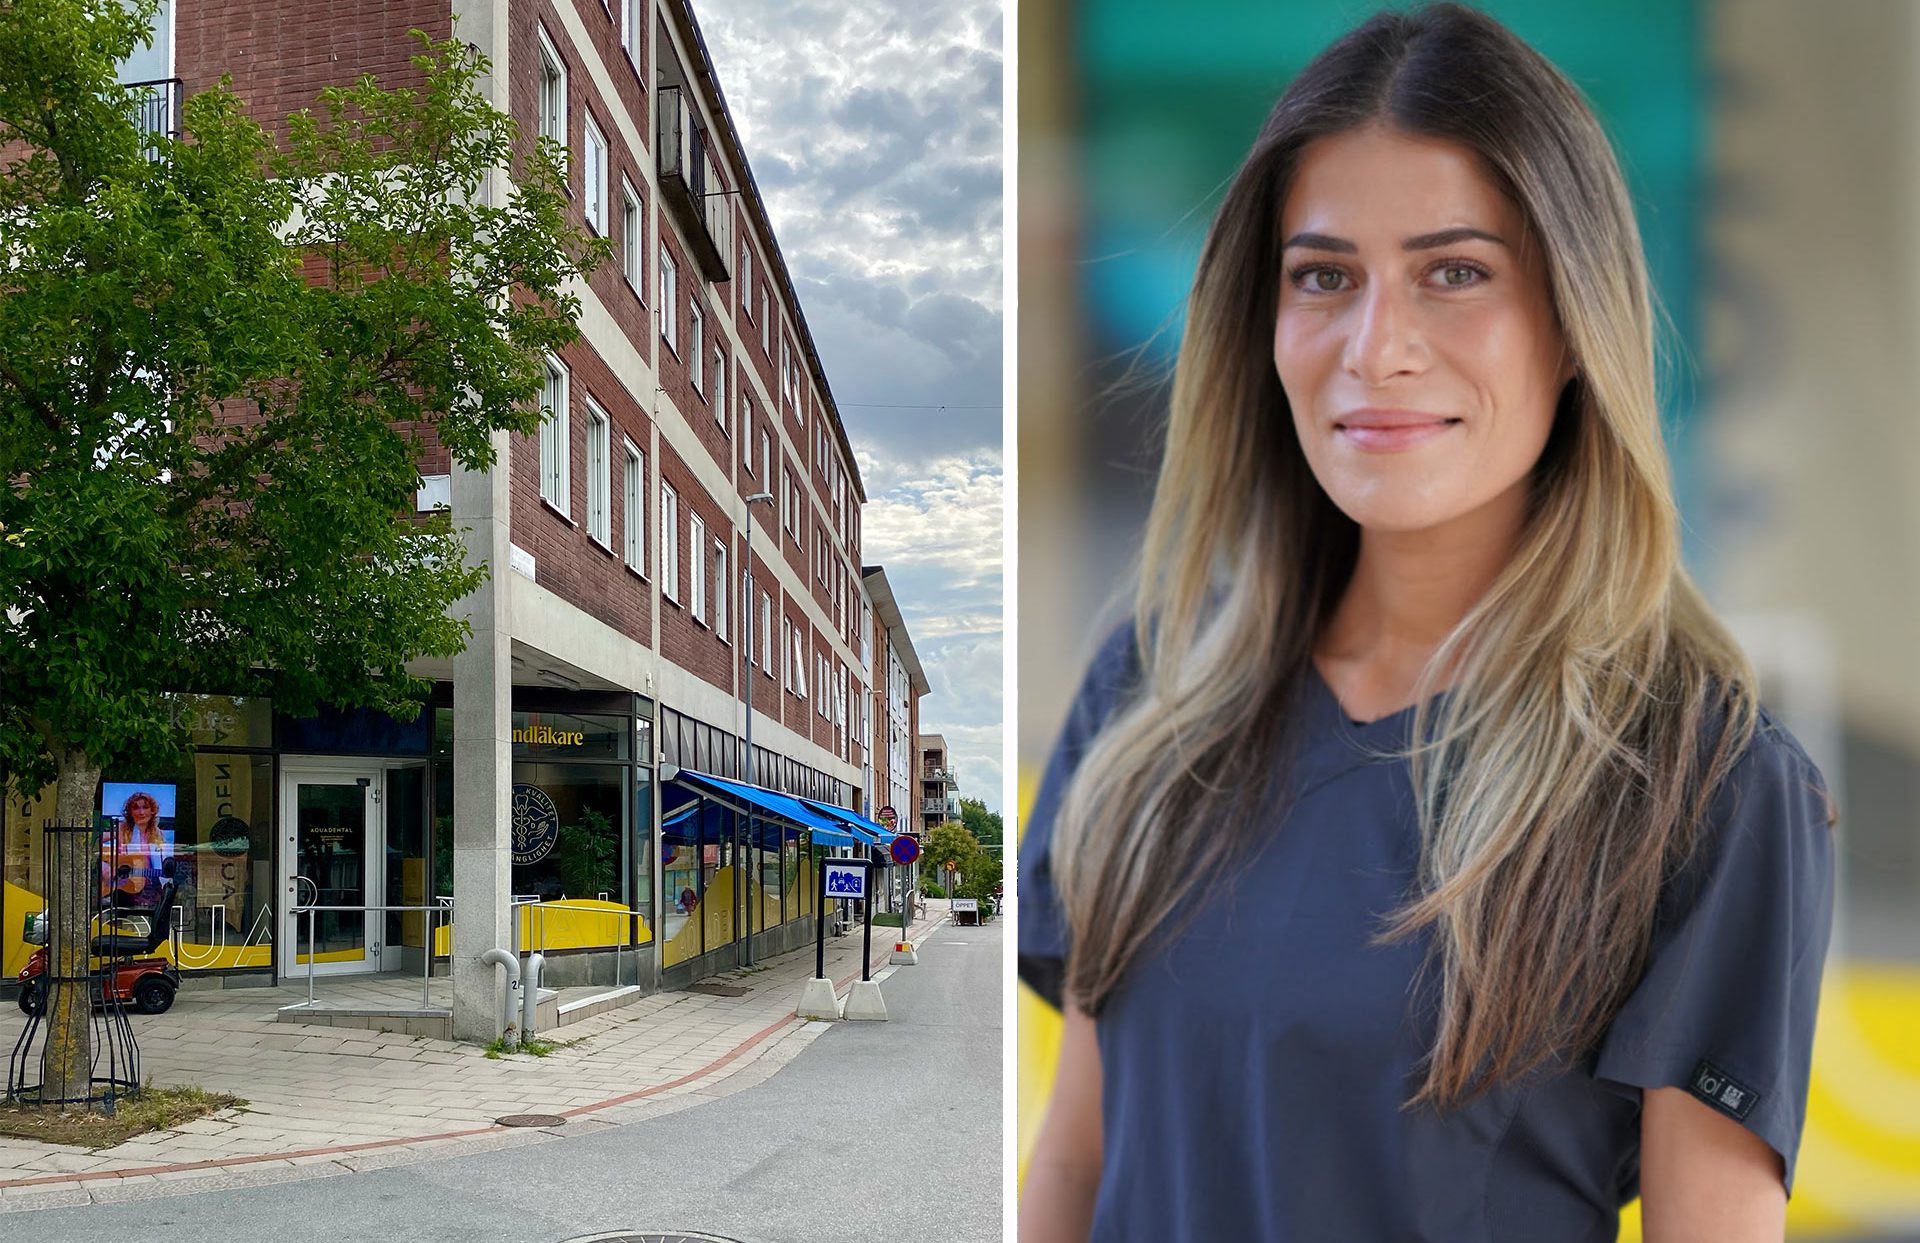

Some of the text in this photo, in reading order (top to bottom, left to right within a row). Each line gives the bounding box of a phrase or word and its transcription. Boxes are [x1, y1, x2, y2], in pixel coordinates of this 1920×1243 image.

[512, 725, 584, 746] ndläkare
[525, 787, 556, 822] KVALITET
[1697, 1067, 1726, 1097] koi
